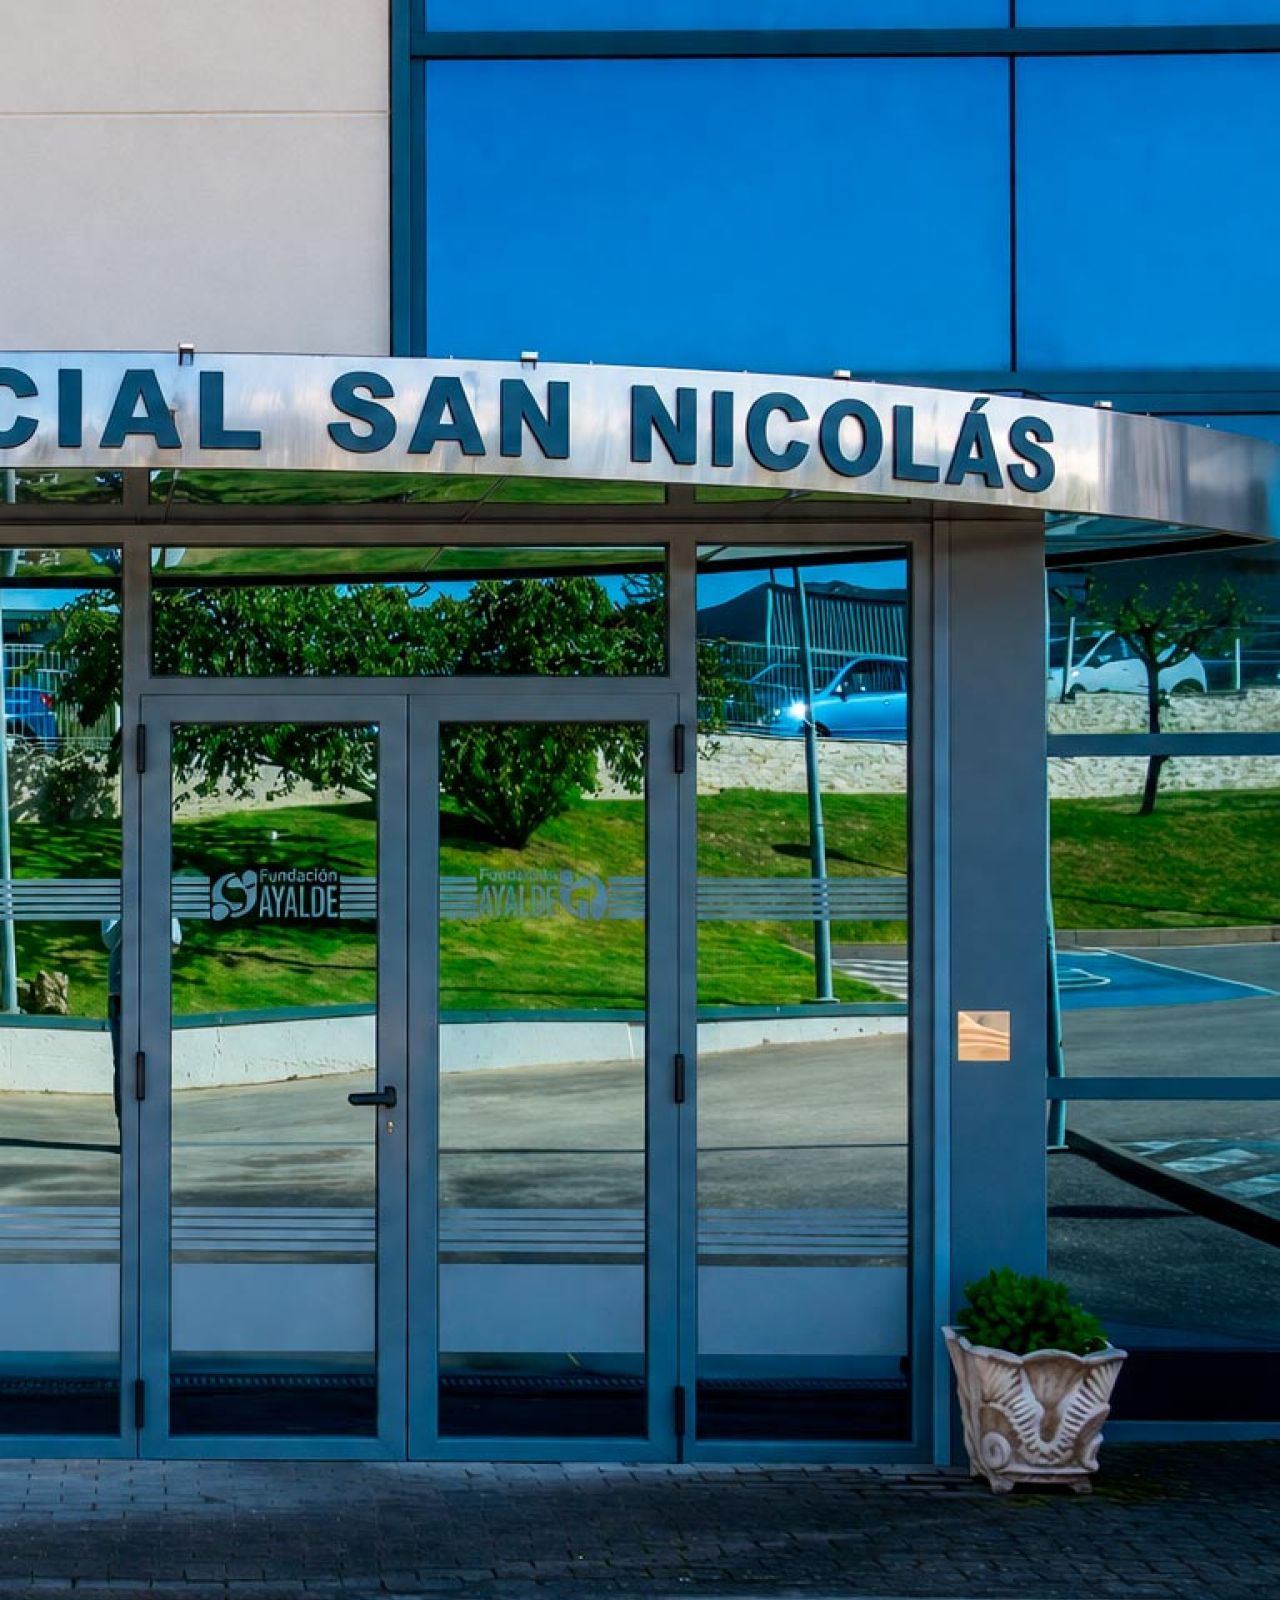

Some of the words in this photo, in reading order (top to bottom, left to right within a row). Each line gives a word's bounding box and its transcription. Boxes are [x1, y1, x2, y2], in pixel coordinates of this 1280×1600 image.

[325, 371, 571, 460] SAN
[630, 384, 1056, 493] NICOLÁS
[260, 867, 338, 882] Fundación
[260, 885, 338, 918] AYALDE
[480, 885, 559, 917] AYALDE
